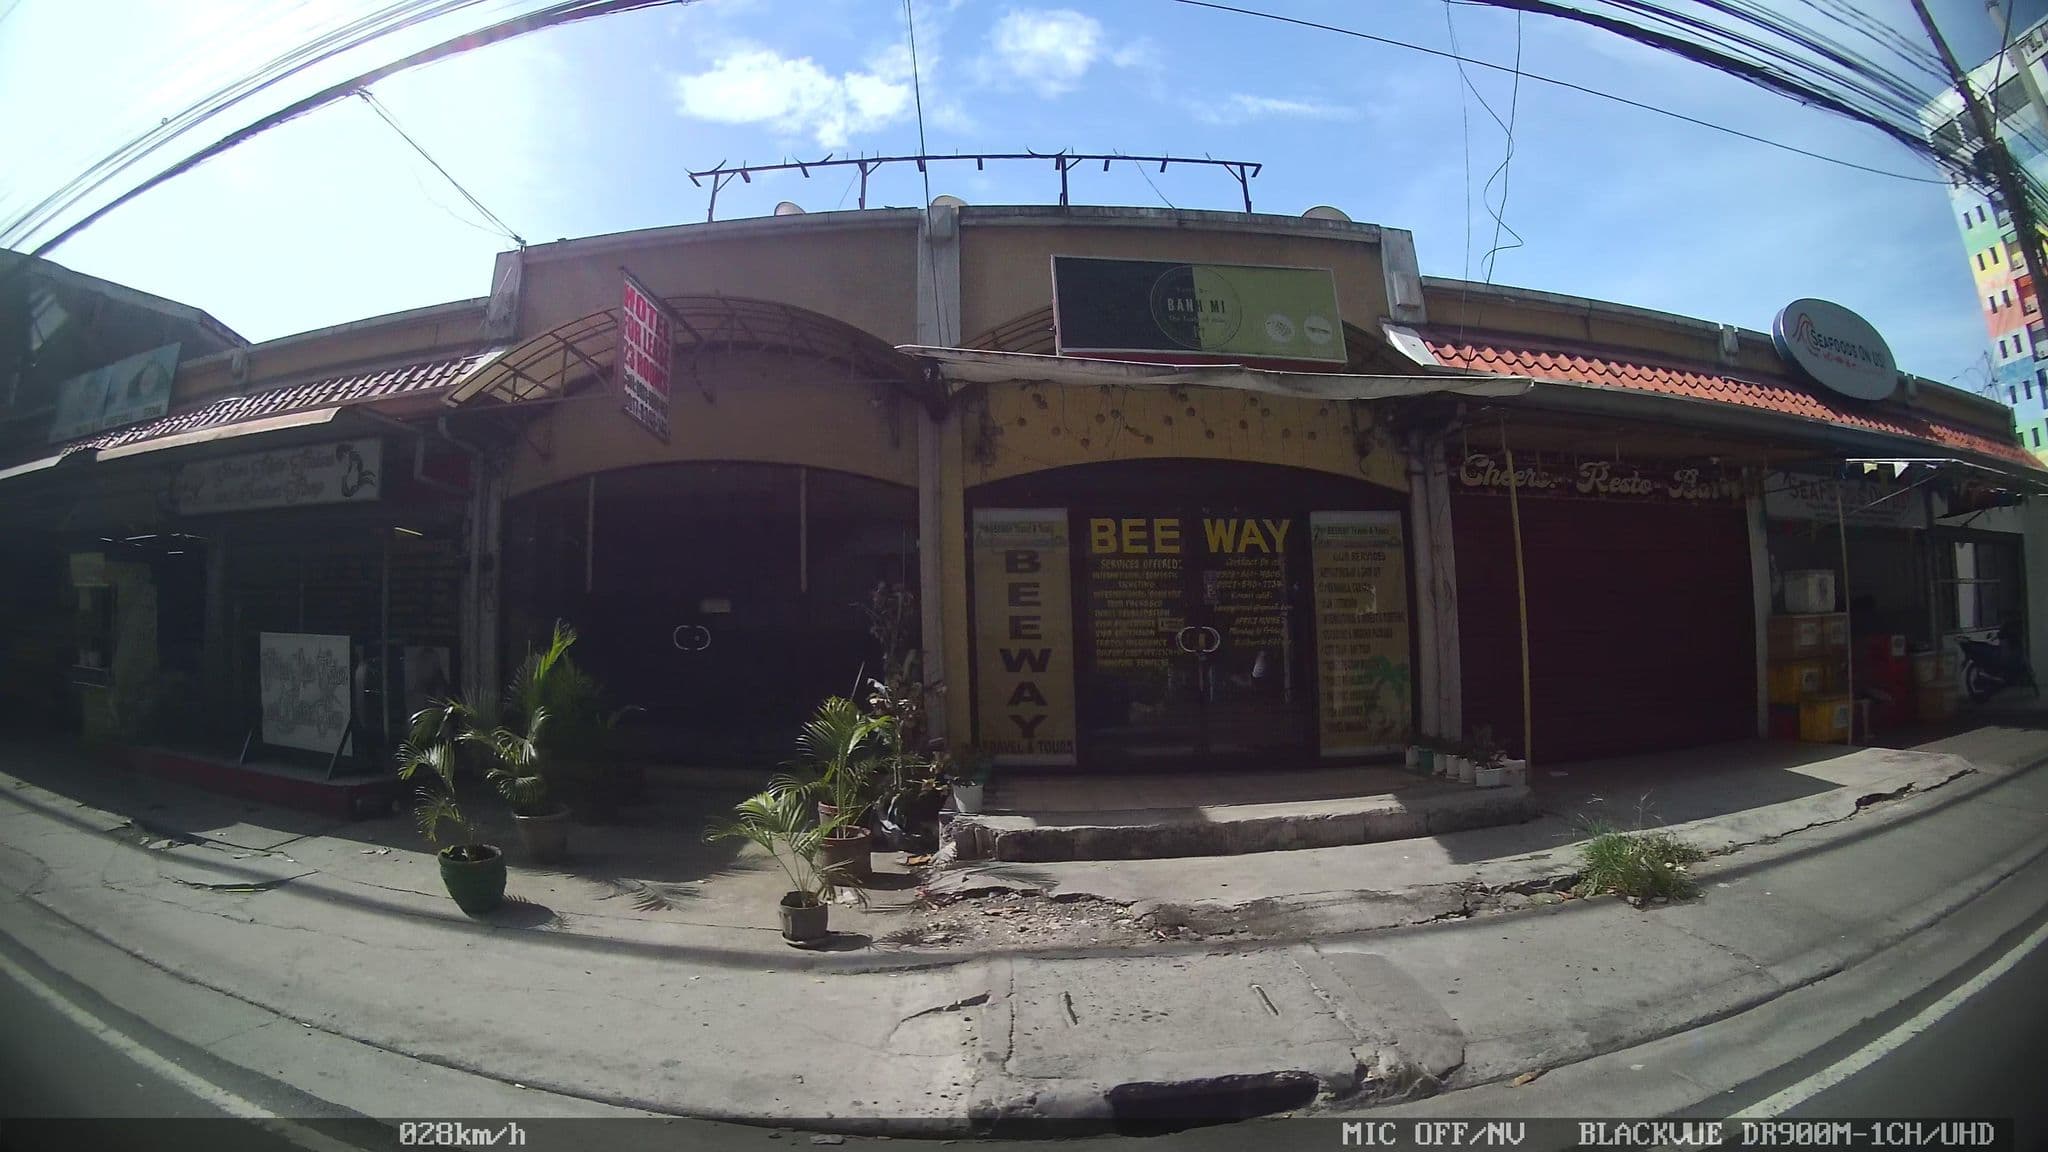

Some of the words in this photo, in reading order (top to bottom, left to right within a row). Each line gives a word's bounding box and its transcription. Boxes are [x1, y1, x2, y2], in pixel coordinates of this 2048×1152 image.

[1811, 329, 1858, 359] SEAFOODS
[1089, 518, 1181, 554] BEE
[1203, 518, 1291, 554] WAY
[1351, 551, 1386, 561] SERVICES
